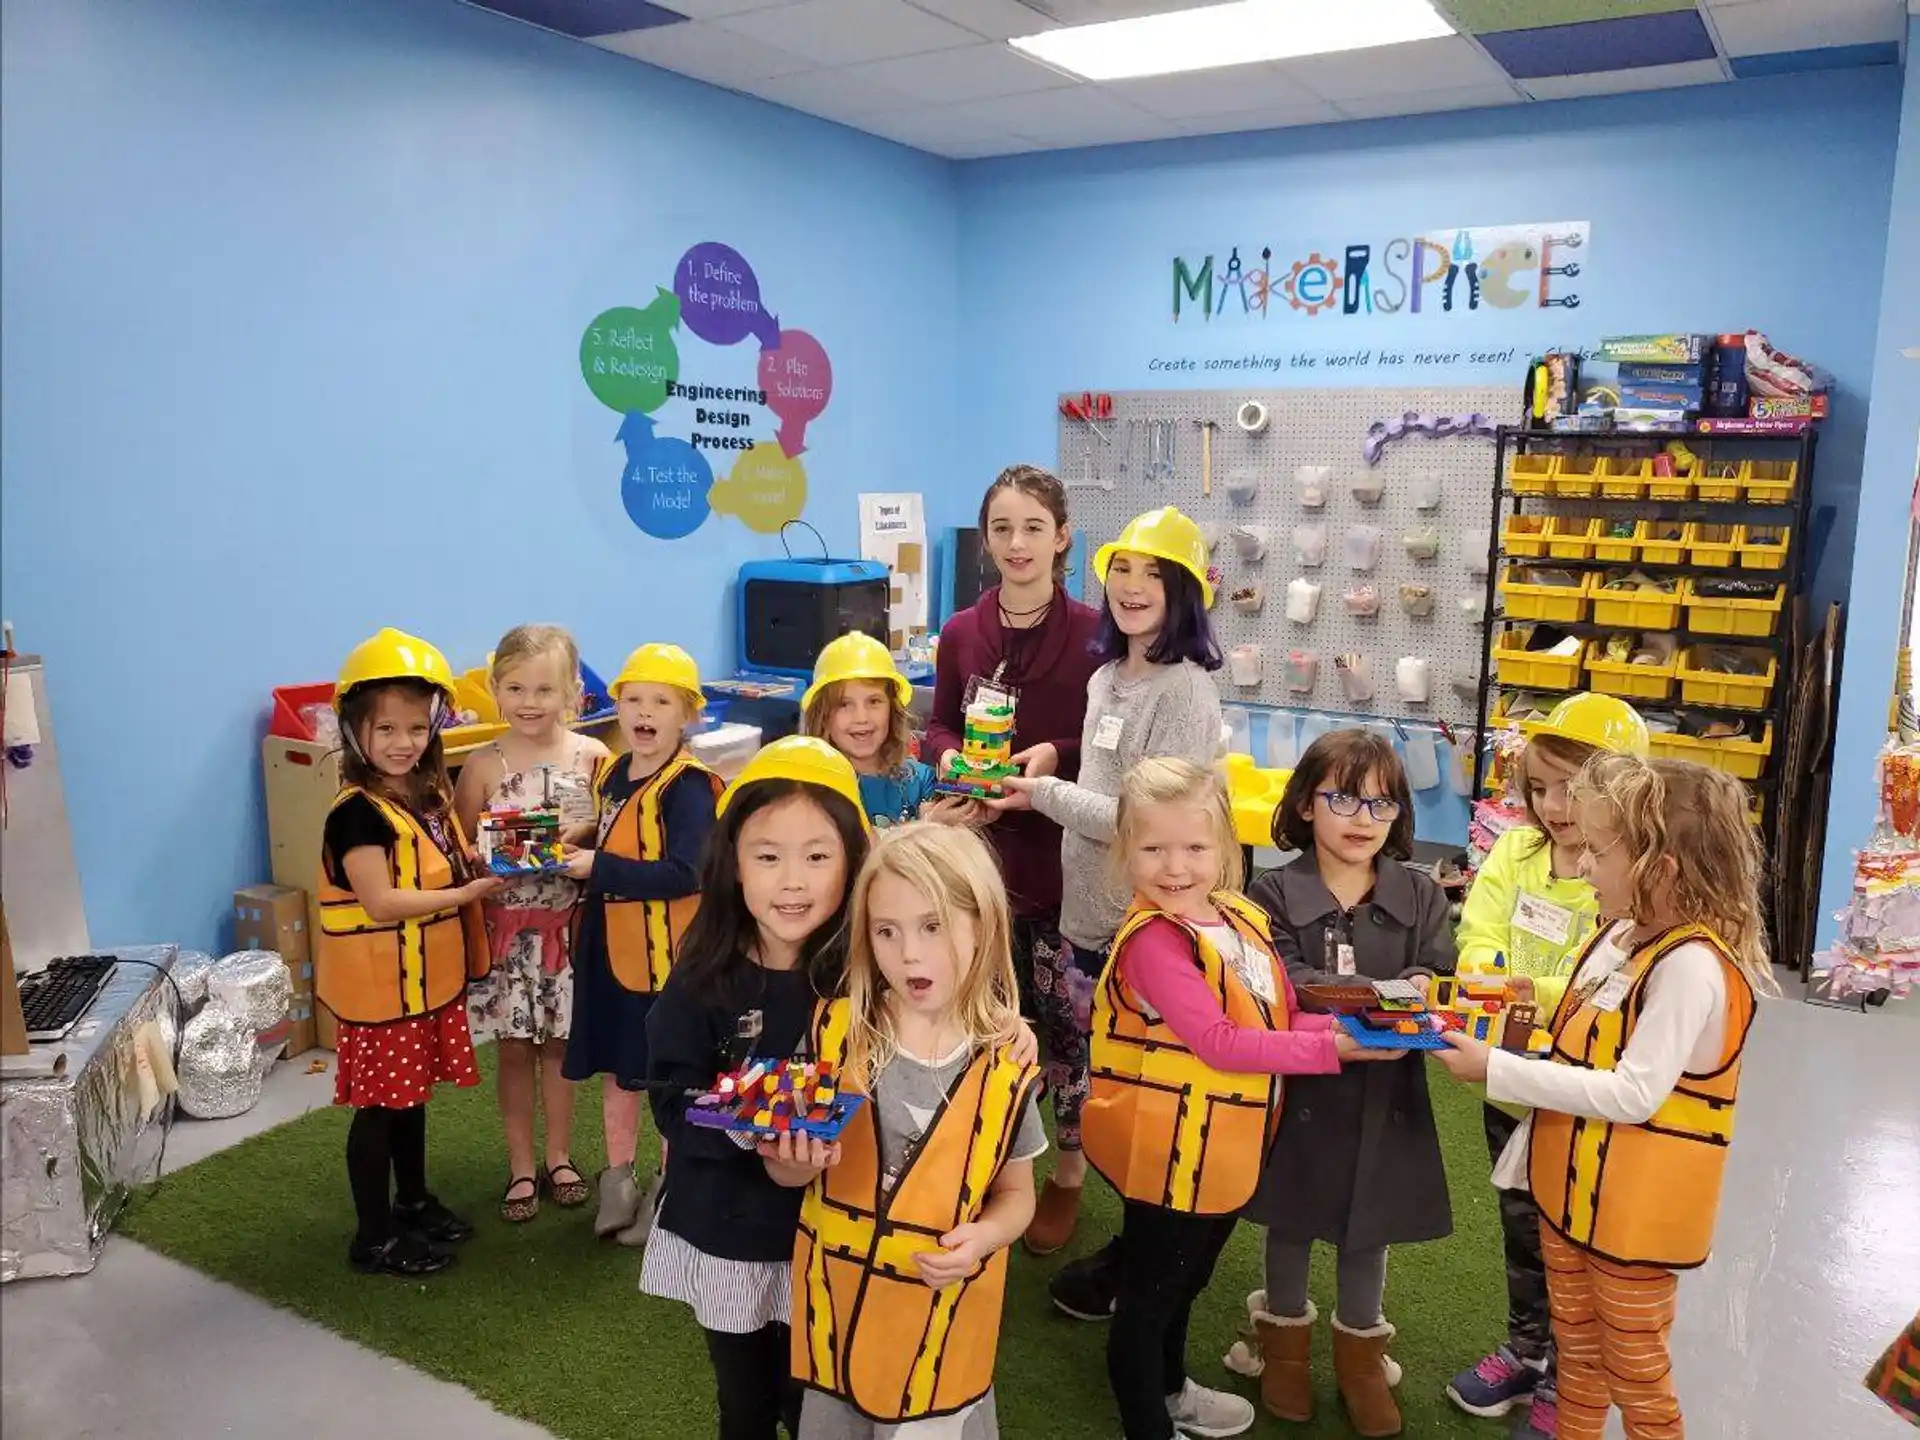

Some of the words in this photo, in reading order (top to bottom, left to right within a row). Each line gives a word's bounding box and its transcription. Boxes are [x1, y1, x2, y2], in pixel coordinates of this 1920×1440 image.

[688, 259, 698, 277] 1.
[704, 261, 742, 285] Define
[688, 282, 709, 305] the
[710, 288, 759, 313] problem
[609, 326, 654, 352] Reflect
[594, 355, 606, 376] &
[609, 355, 668, 384] Redesign
[786, 356, 808, 378] Plan
[1148, 357, 1197, 371] Create
[1204, 353, 1282, 372] something
[1291, 352, 1317, 367] the
[1325, 350, 1371, 366] world
[1378, 350, 1405, 365] has
[1413, 352, 1461, 365] never
[1469, 347, 1515, 363] seen!
[666, 379, 768, 406] Engineering
[777, 379, 825, 401] Solutions
[696, 407, 751, 428] Design
[691, 432, 755, 451] Process
[647, 466, 675, 483] Test
[676, 463, 698, 483] the
[652, 487, 691, 510] Model
